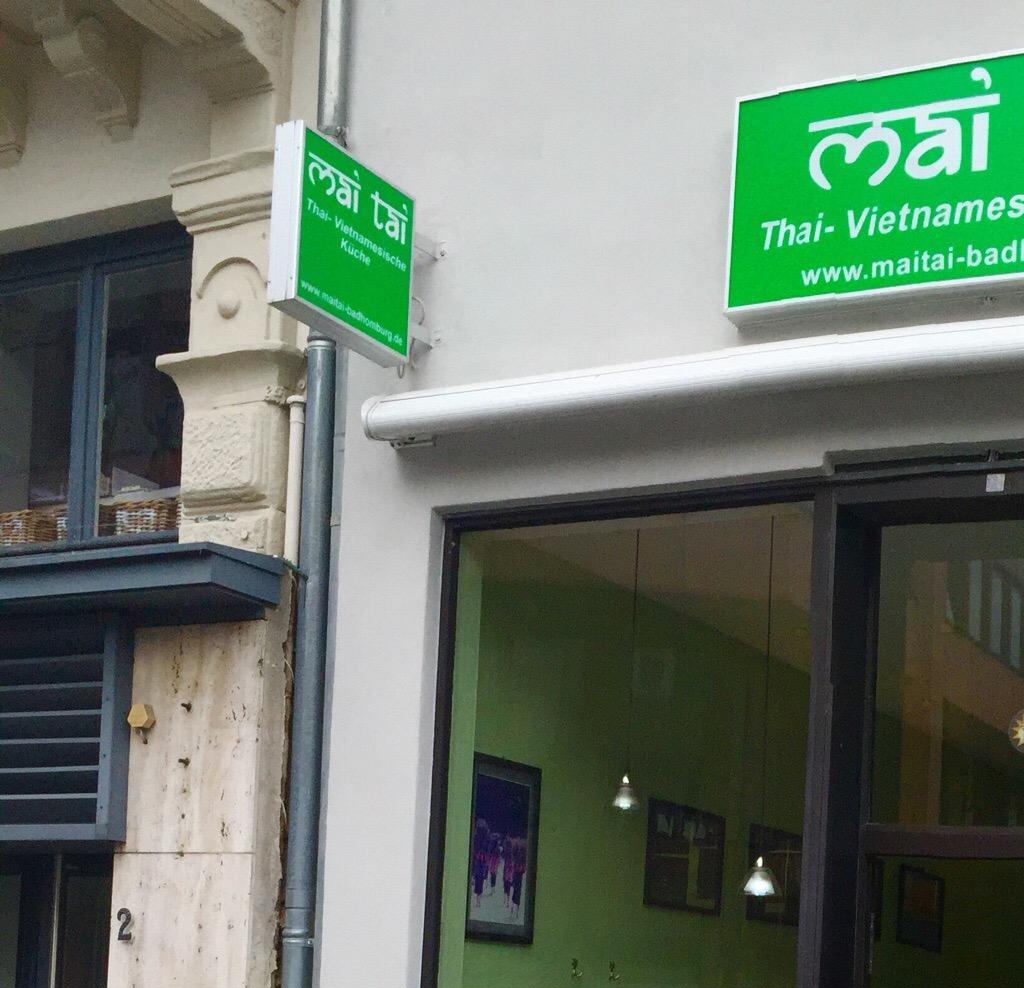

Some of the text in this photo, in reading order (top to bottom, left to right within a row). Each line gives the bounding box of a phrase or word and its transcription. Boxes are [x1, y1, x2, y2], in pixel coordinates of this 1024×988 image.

[808, 67, 1000, 191] mai
[308, 152, 409, 246] mai tai
[307, 197, 407, 272] Thai- Vietnamesische
[340, 237, 371, 267] Küche
[761, 218, 835, 251] Thai-
[300, 279, 403, 346] www.maitai-badhomburg.de
[117, 907, 132, 941] 2
